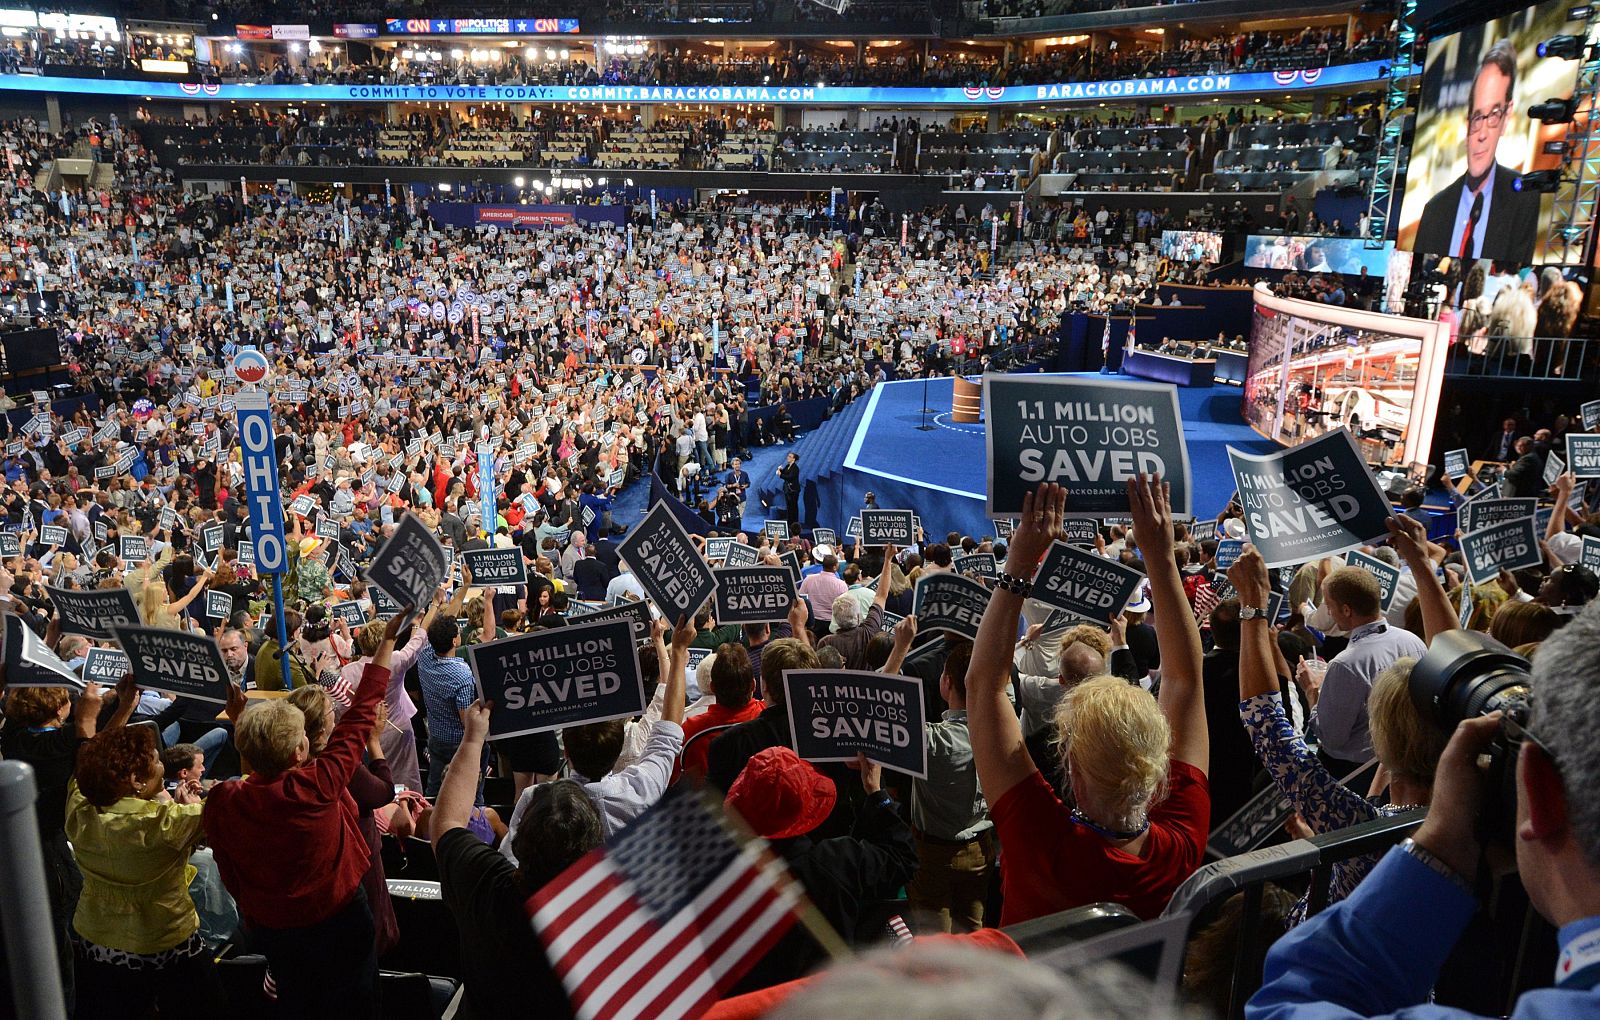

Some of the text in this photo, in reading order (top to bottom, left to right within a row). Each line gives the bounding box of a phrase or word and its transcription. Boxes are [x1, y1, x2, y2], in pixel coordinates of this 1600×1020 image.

[406, 20, 430, 32] CNN
[534, 19, 558, 32] CNN
[350, 88, 814, 100] COMMIT TO VOTE TODAY: COMMIT.BARACKOBAMA.COM
[1037, 76, 1230, 98] BARACKOBAMA.COM
[1018, 400, 1154, 424] 1.1 MILLION
[1019, 425, 1160, 447] AUTO JOBS
[1019, 448, 1166, 482] SAVED
[1252, 456, 1335, 490] MILLION
[243, 415, 282, 569] OHIO
[480, 455, 490, 531] HAWAII
[1246, 474, 1345, 508] AUTO JOBS
[1250, 494, 1360, 539] SAVED
[870, 529, 907, 538] SAVED
[1471, 527, 1523, 549] 1.1 MILLION
[658, 522, 704, 588] 1.1 MILLION
[1473, 534, 1525, 558] AUTO JOBS
[1474, 543, 1528, 570] SAVED
[476, 567, 518, 577] SAVED
[637, 541, 690, 609] SAVED
[649, 533, 698, 597] AUTO JOBS
[1059, 556, 1126, 585] 1.1 MILLION
[1364, 563, 1393, 581] MILLION
[727, 584, 787, 595] AUTO JOBS
[740, 575, 784, 584] MILLION
[1053, 566, 1121, 595] AUTO JOBS
[1376, 577, 1391, 589] OBS
[69, 598, 120, 607] MILLION
[727, 594, 789, 610] SAVED
[1045, 576, 1114, 608] SAVED
[65, 611, 129, 629] SAVED
[91, 606, 124, 615] JOBS
[139, 645, 214, 666] AUTO JOBS
[151, 636, 209, 655] MILLION
[499, 638, 613, 668] 1.1 MILLION
[141, 656, 220, 682] SAVED
[503, 654, 617, 685] AUTO JOBS
[504, 671, 621, 710] SAVED
[808, 686, 905, 706] 1.1 MILLION
[532, 701, 598, 716] BARACKOBAMA.COM
[811, 701, 908, 723] AUTO JOBS
[812, 716, 910, 748] SAVED
[395, 884, 439, 894] MILLION
